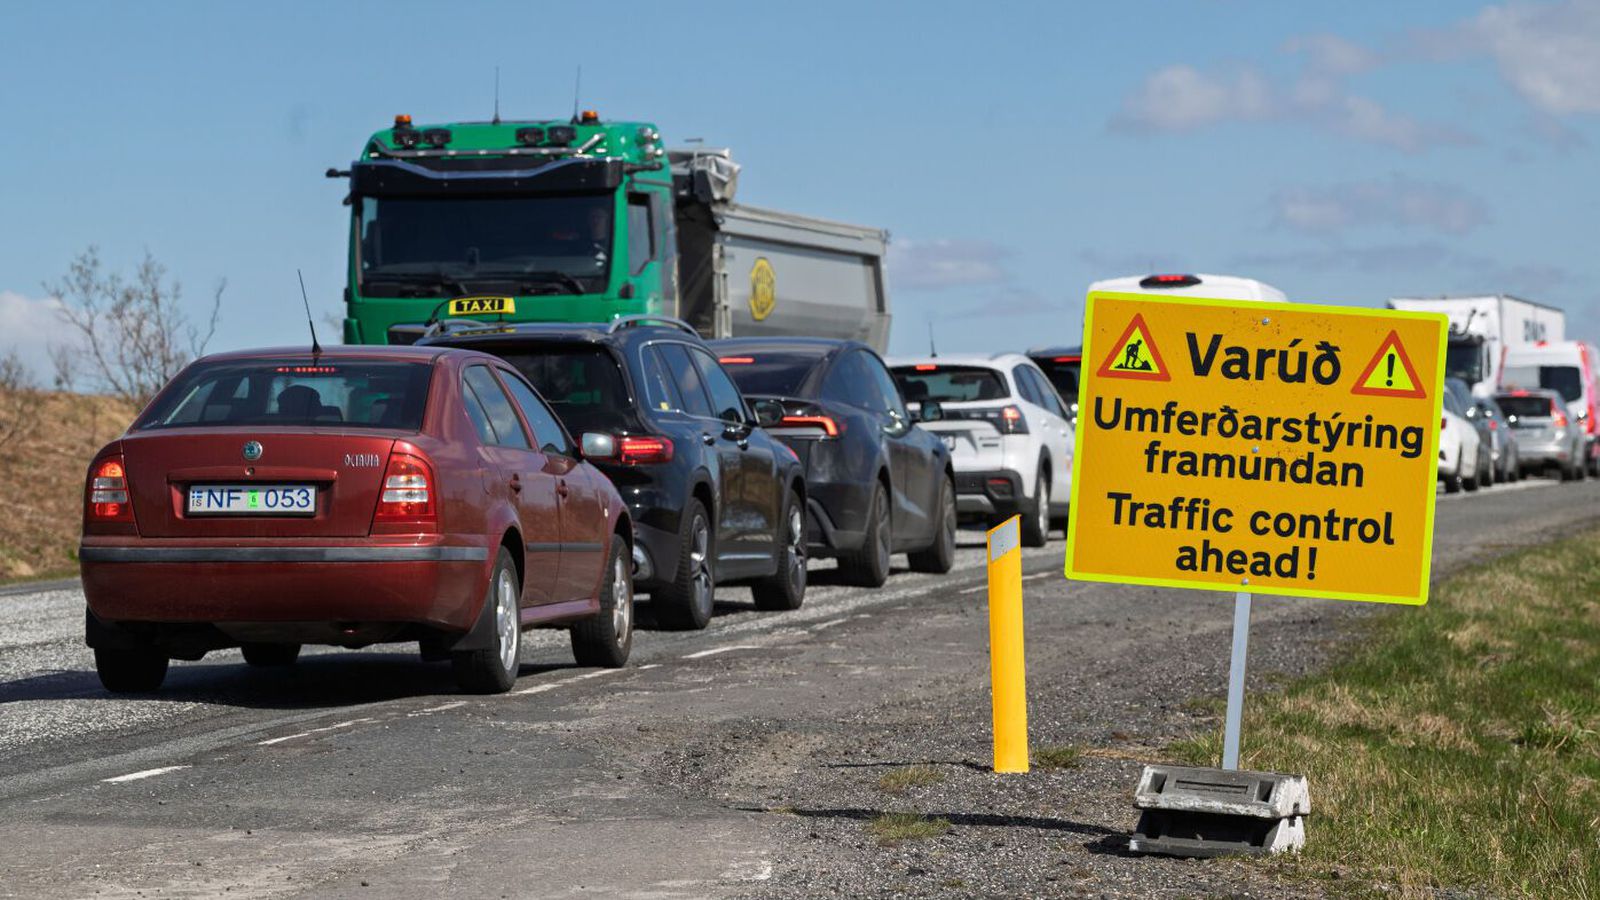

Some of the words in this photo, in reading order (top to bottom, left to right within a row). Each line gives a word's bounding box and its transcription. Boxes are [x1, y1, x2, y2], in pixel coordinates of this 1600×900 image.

[461, 300, 499, 312] TAXI
[1185, 331, 1342, 387] Varúð
[1094, 396, 1425, 459] Umferðarstýring
[344, 453, 379, 468] OCTAVIA
[1144, 440, 1365, 488] framundan
[206, 488, 242, 508] NF
[264, 488, 311, 508] 053
[1106, 491, 1234, 535] Traffic
[1249, 510, 1395, 547] control
[1175, 539, 1318, 581] ahead!
